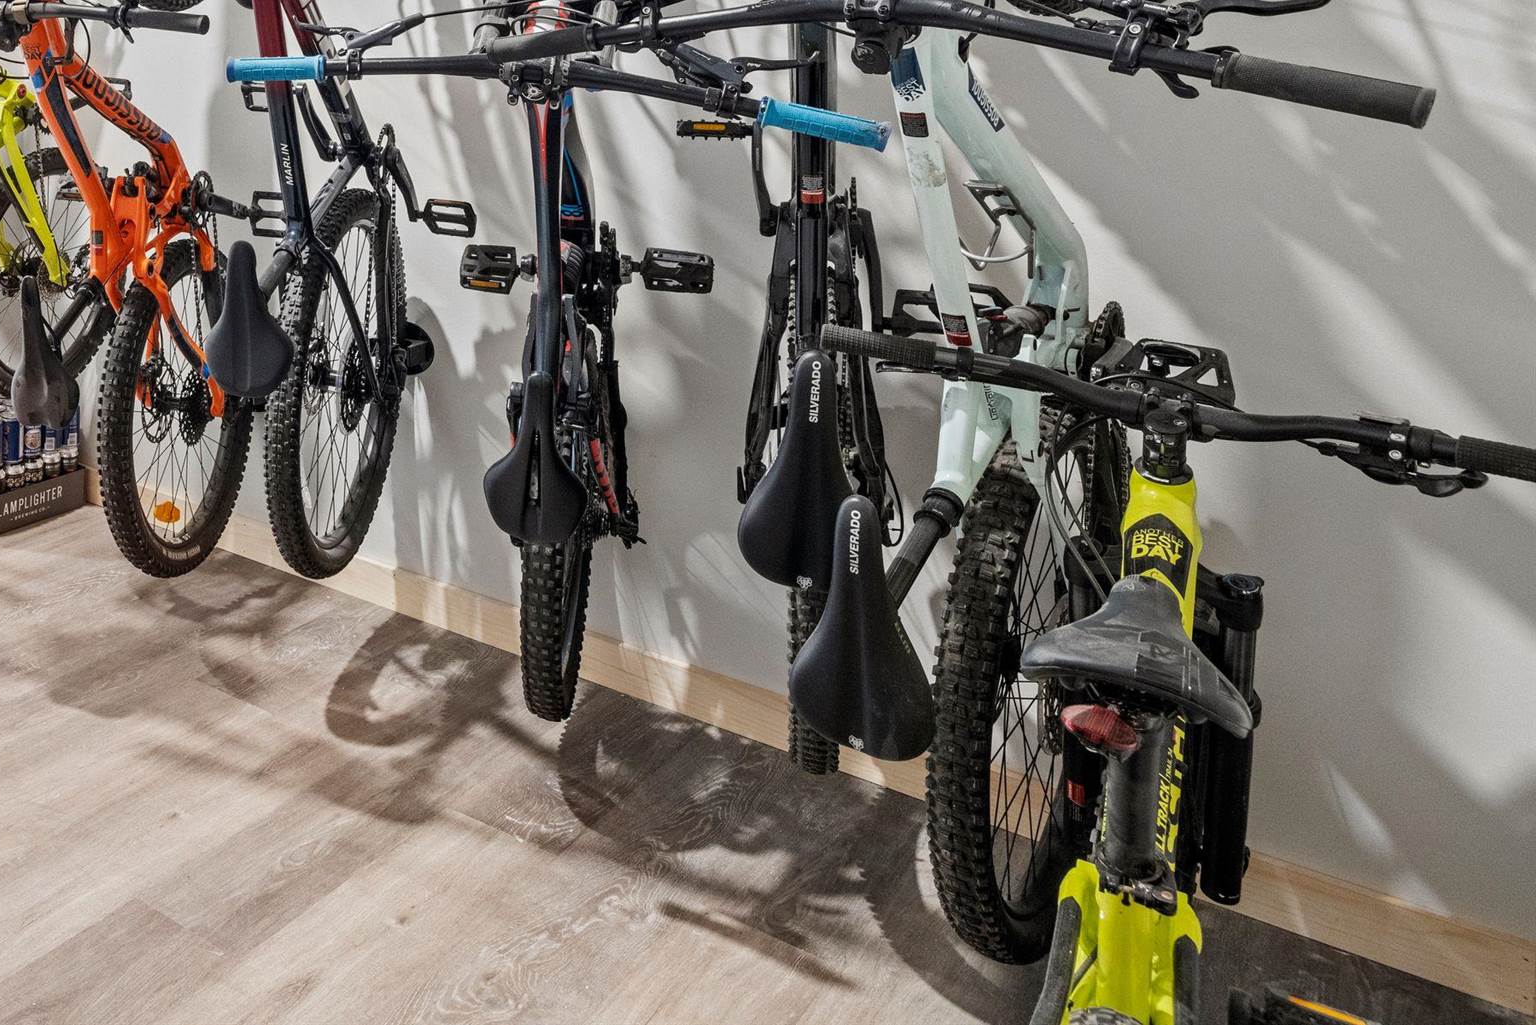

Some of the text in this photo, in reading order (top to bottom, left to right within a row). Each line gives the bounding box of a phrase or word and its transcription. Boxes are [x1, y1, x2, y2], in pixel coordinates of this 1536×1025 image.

[280, 142, 294, 186] MARLIN
[808, 360, 822, 424] SILVERADO
[849, 509, 861, 575] SILVERADO
[1131, 544, 1181, 566] DAY
[1132, 533, 1183, 554] BEST
[1134, 527, 1184, 545] ANOTHER
[1156, 779, 1172, 831] TRACK
